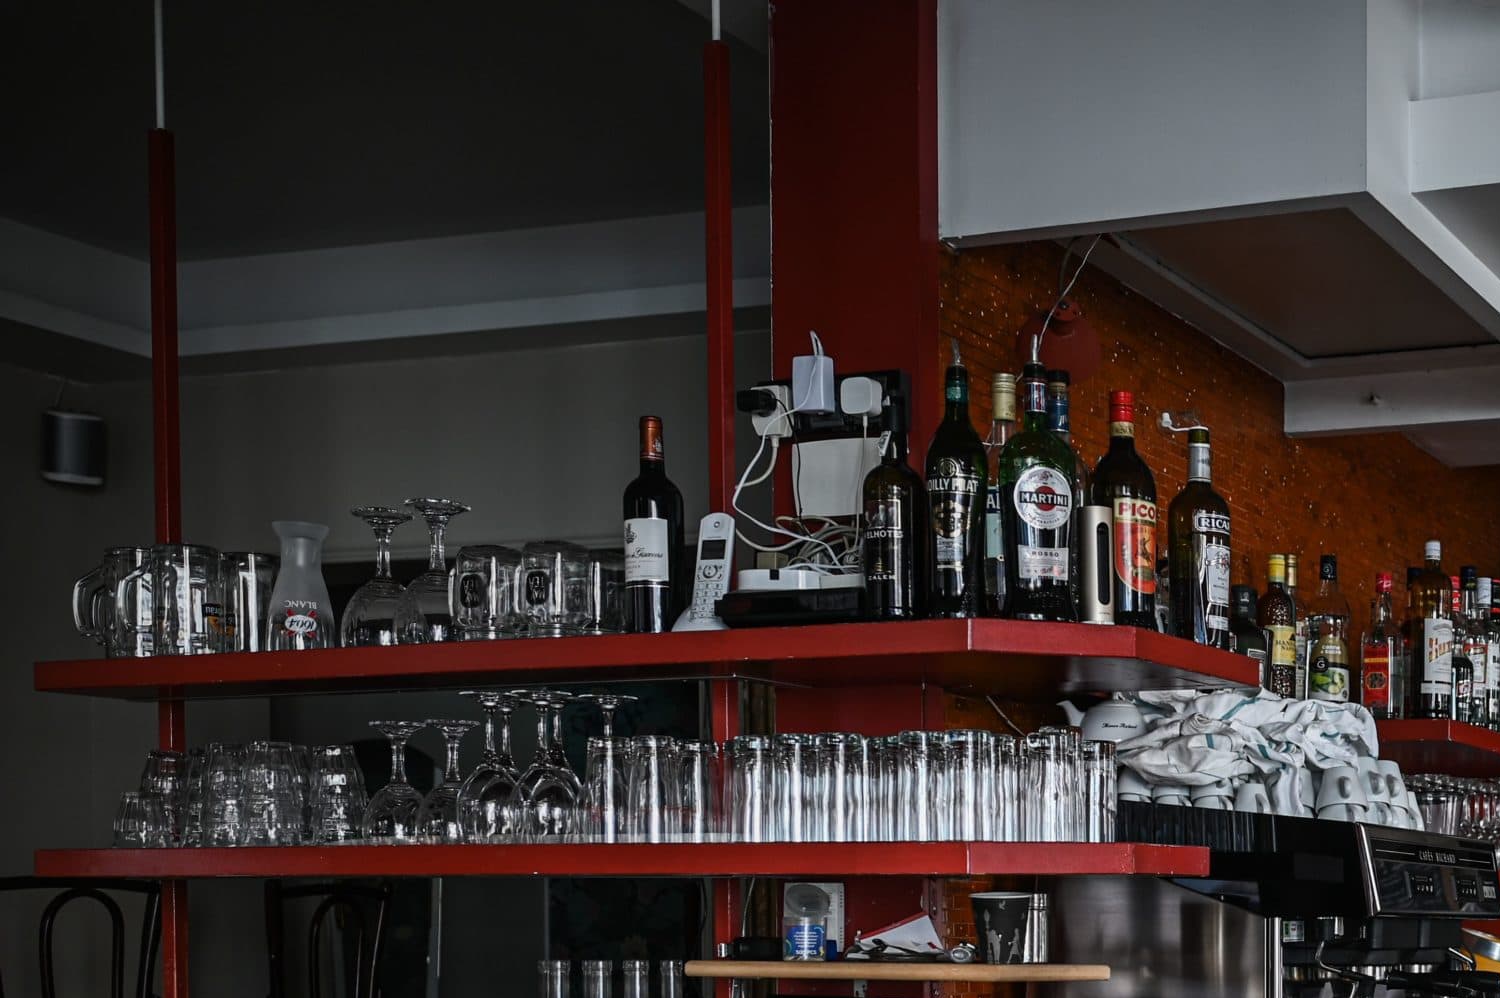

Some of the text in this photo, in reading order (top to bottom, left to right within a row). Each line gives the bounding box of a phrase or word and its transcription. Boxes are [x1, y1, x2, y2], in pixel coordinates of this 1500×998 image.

[1021, 492, 1069, 506] MARTINI
[1119, 502, 1156, 520] PICO
[1201, 517, 1230, 530] RICA
[1031, 550, 1059, 558] ROSSO
[283, 599, 317, 610] BLANC
